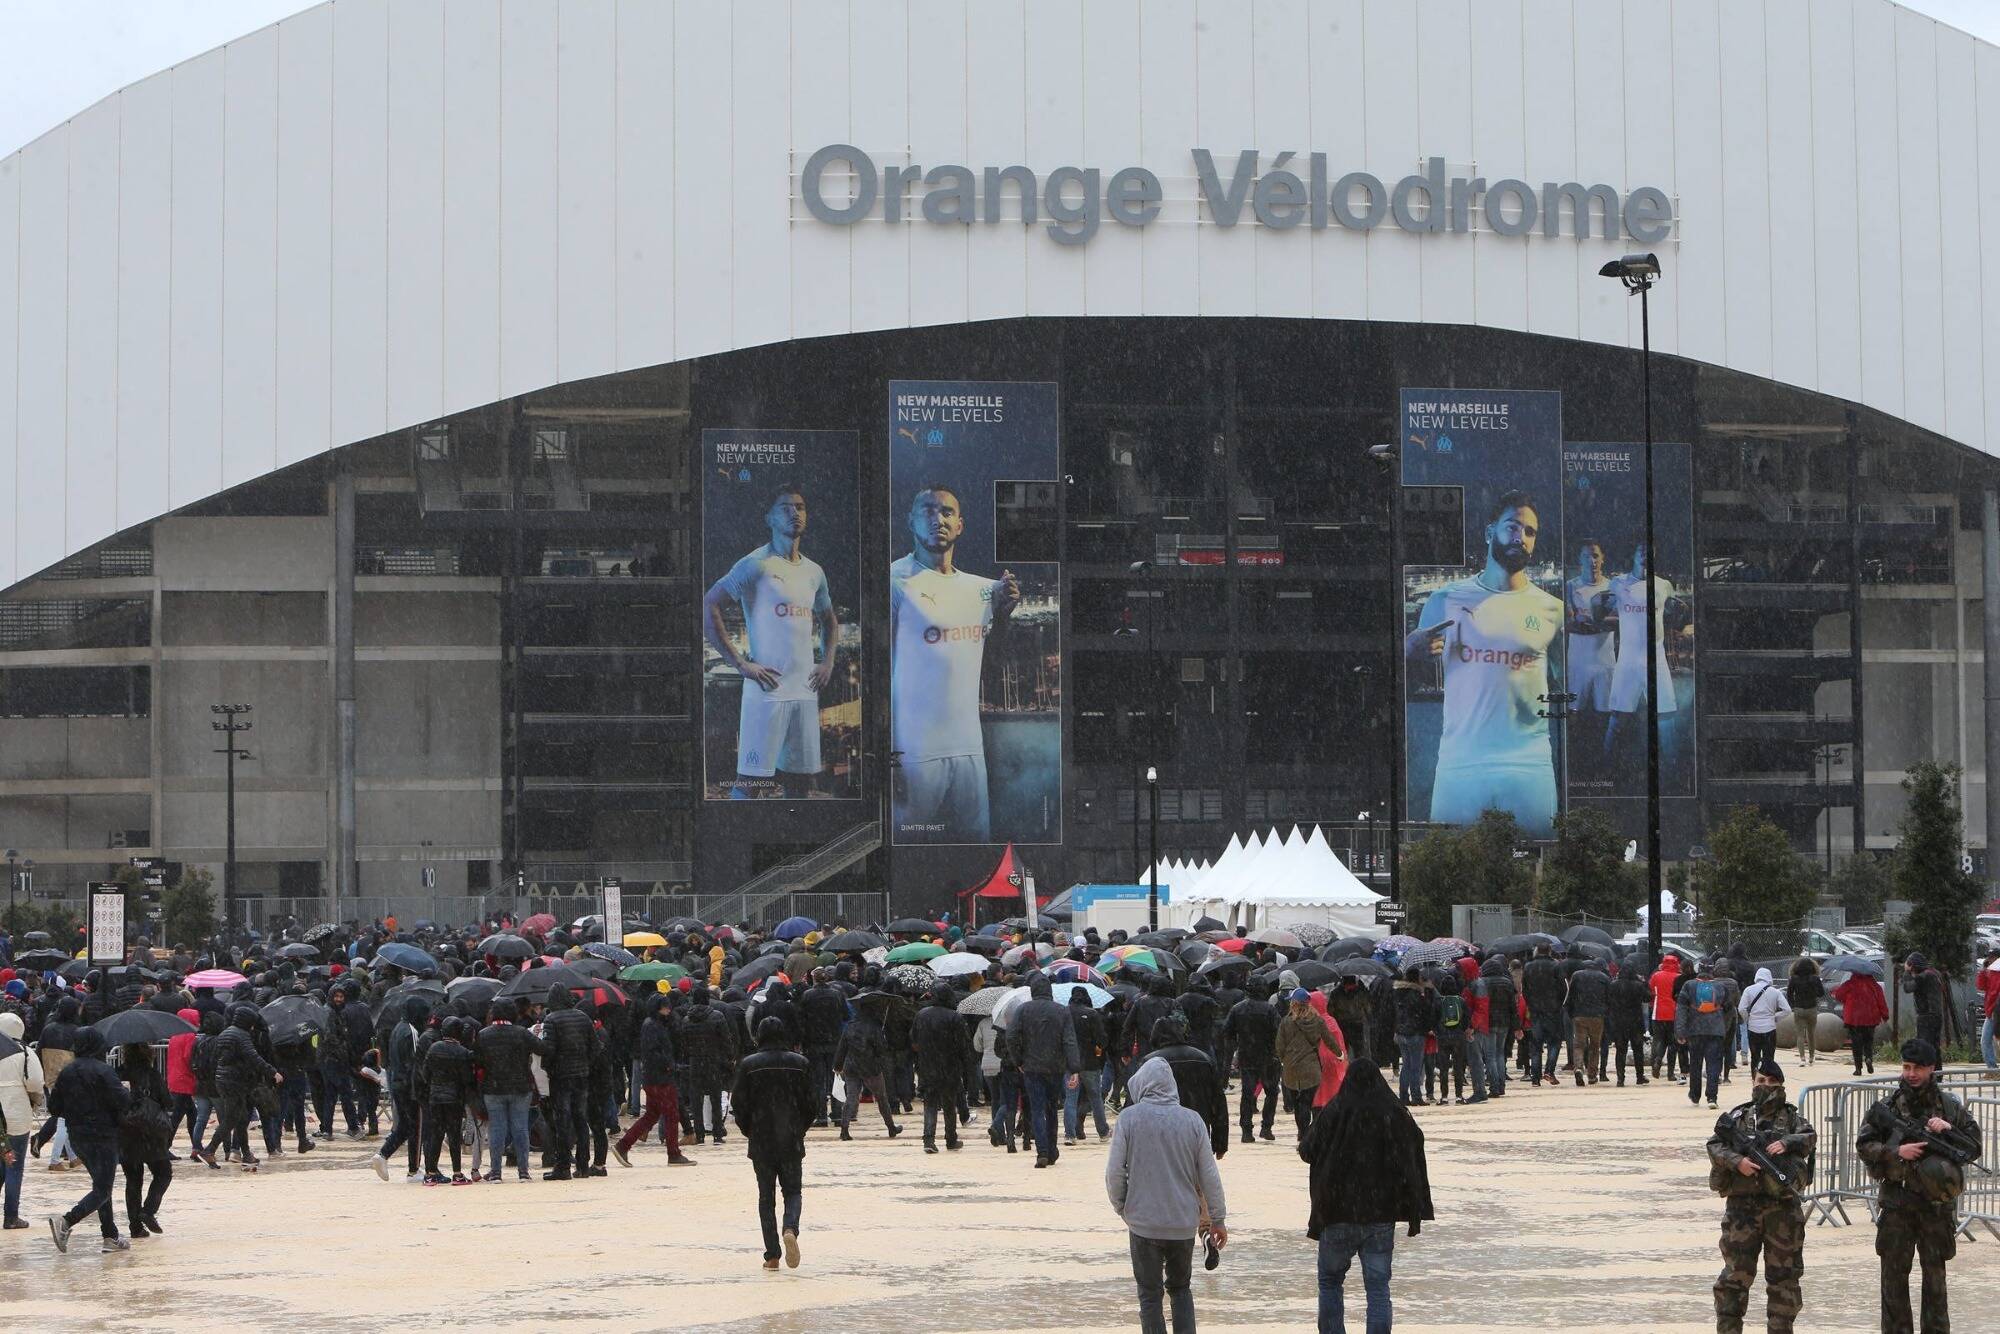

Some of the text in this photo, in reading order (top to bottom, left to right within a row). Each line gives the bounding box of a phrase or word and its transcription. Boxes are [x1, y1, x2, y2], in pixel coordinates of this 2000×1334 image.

[801, 143, 1673, 246] Orange Vélodrome
[897, 395, 1004, 407] NEW MARSEILLE
[1408, 402, 1509, 415] NEW MARSEILLE
[897, 408, 1004, 423] NEW LEVELS
[1409, 415, 1509, 430] NEW LEVELS
[716, 443, 796, 453] NEW MARSEILLE
[717, 453, 796, 464] NEW LEVELS
[1563, 451, 1631, 461] EW MARSEILLE
[1567, 461, 1631, 472] EW LEVELS
[425, 867, 436, 888] 10
